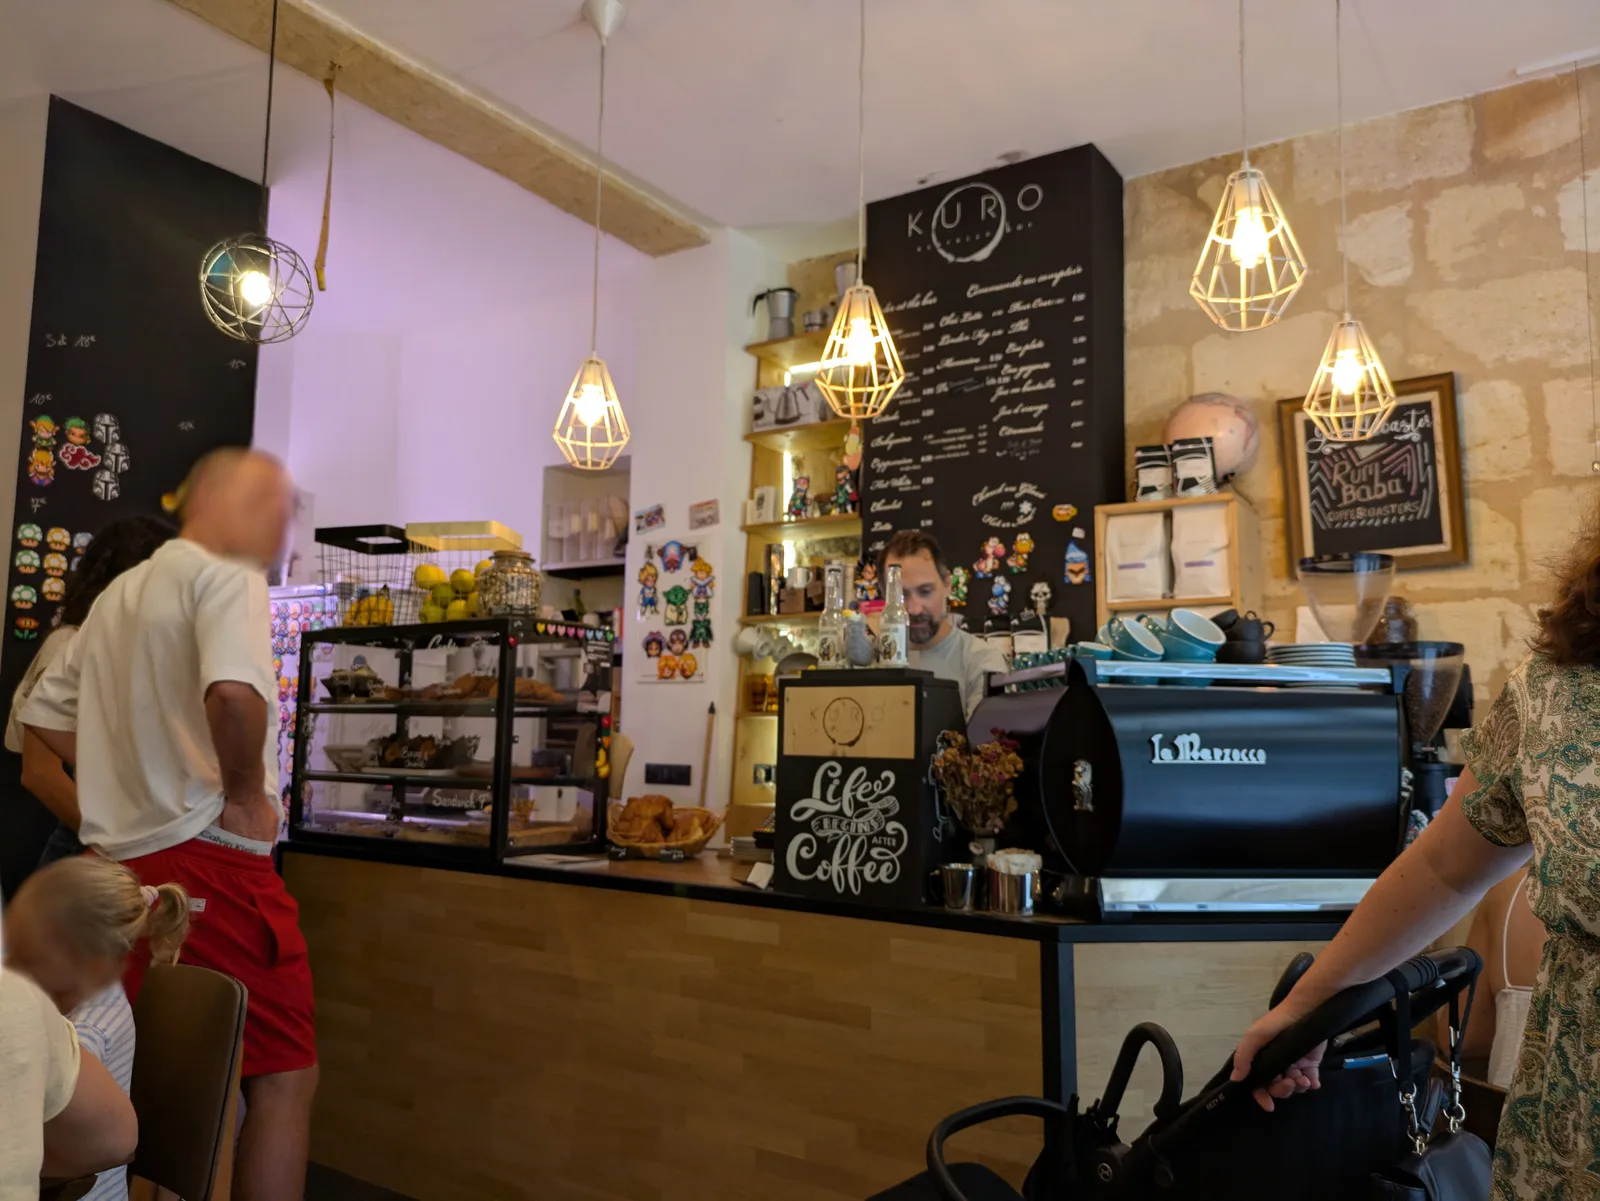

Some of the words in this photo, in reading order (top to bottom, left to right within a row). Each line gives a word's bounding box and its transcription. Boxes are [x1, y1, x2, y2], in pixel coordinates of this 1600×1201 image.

[907, 183, 1044, 238] KURO
[1174, 733, 1267, 764] Marzocco
[790, 761, 896, 821] Life
[821, 814, 880, 834] BEGINS
[200, 830, 234, 849] Calvin
[235, 843, 259, 854] Klein
[872, 835, 897, 847] AFTER
[786, 821, 908, 895] Coffee
